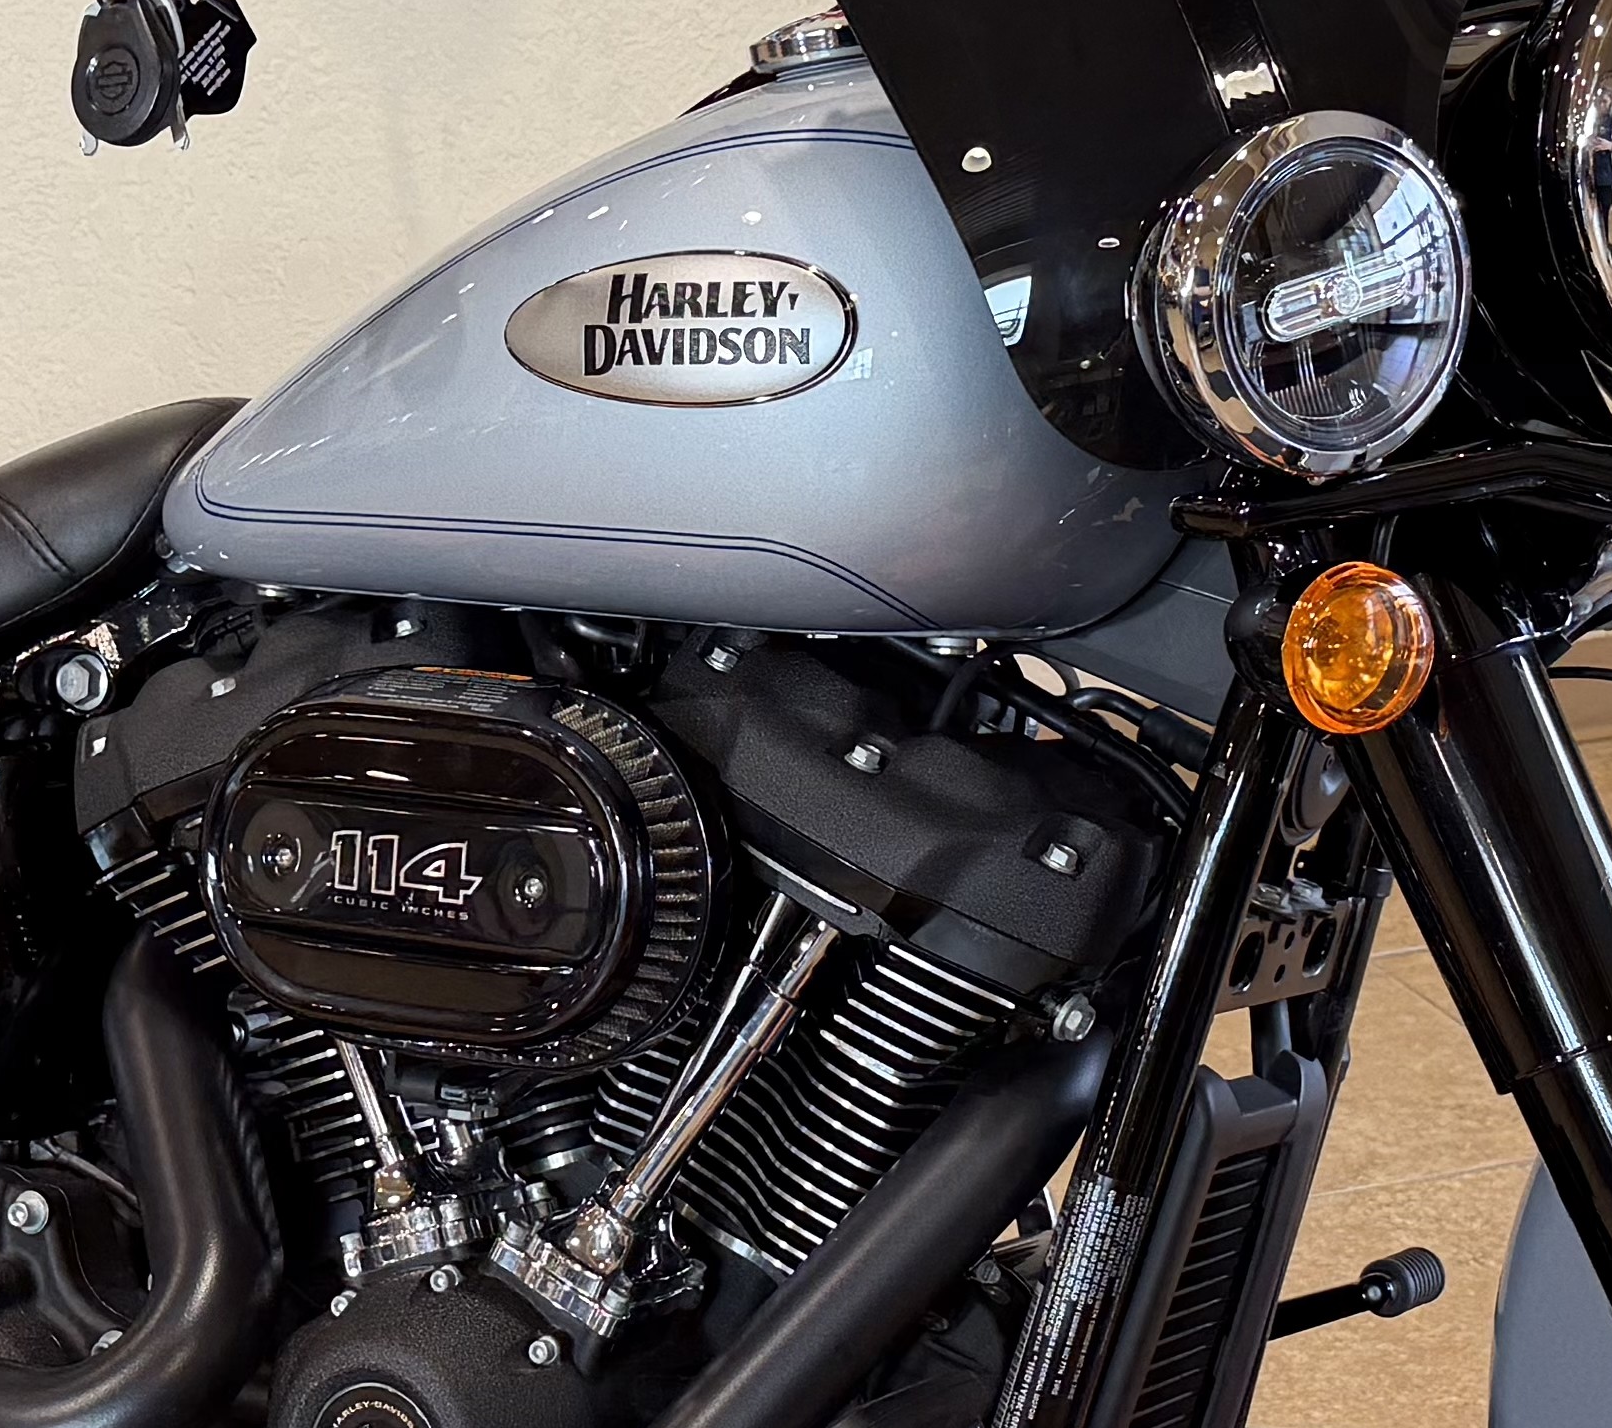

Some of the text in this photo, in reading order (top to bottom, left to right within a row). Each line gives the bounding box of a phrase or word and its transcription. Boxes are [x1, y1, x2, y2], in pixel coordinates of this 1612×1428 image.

[583, 323, 811, 376] DAVIDSON
[331, 829, 484, 905] 114
[333, 894, 470, 921] CUBIC INCHES
